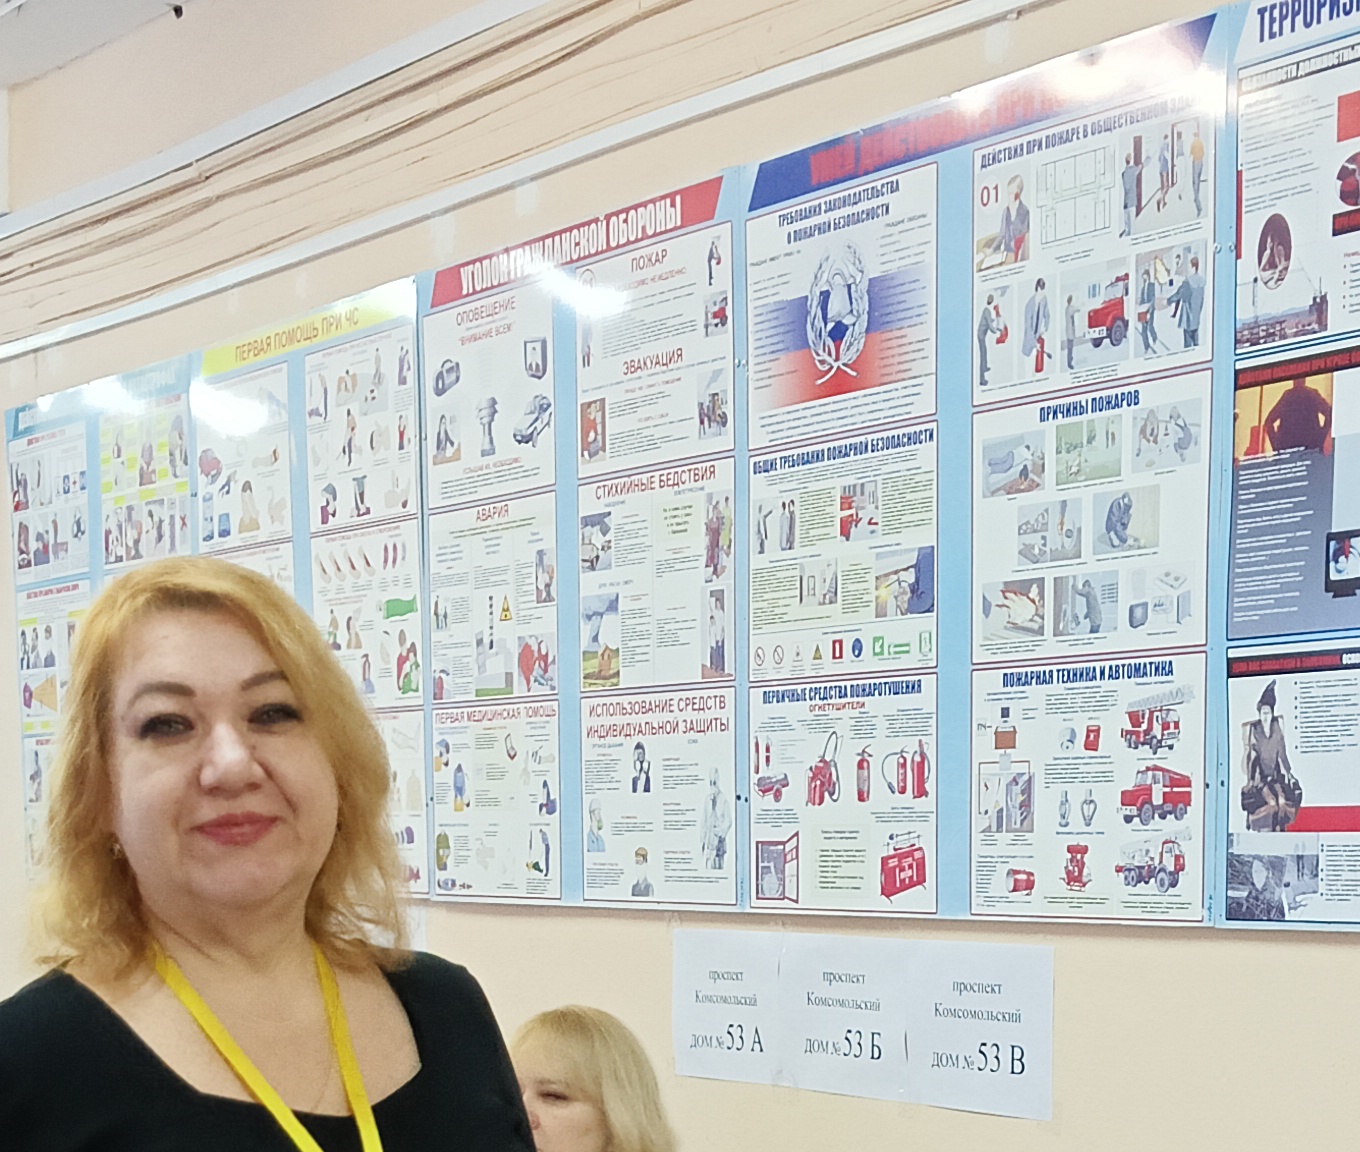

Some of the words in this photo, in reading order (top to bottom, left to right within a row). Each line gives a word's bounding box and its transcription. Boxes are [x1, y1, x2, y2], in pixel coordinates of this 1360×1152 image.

[980, 142, 1024, 171] ДЕЙСТВИЯ
[1026, 137, 1043, 155] ПРИ
[1045, 127, 1081, 150] ПОЖАРЕ
[1083, 124, 1089, 138] В
[778, 202, 822, 227] ТРЕБОВАНИЯ
[824, 179, 900, 214] ЗАКОНОДАТЕЛЬСТВА
[981, 184, 999, 207] 01
[793, 218, 831, 243] ПОЖАРНОЙ
[833, 202, 890, 231] БЕЗОПАСНОСТИ
[460, 250, 509, 295] УГОЛОК
[609, 194, 682, 247] ОБОРОНЫ
[631, 249, 668, 273] ПОЖАР
[456, 296, 516, 326] ОПОВЕЩЕНИЕ
[235, 335, 272, 363] ПЕРВАЯ
[274, 320, 319, 350] ПОМОЩЬ
[321, 313, 342, 336] ПРИ
[345, 307, 359, 327] ЧС
[623, 347, 683, 376] ЭВАКУАЦИЯ
[1040, 398, 1089, 423] ПРИЧИНЫ
[1091, 389, 1140, 414] ПОЖАРОВ
[753, 457, 778, 475] ОБЩИЕ
[779, 448, 825, 469] ТРЕБОВАНИЯ
[827, 438, 869, 461] ПОЖАРНОЙ
[871, 427, 934, 453] БЕЗОПАСНОСТИ
[595, 475, 656, 500] СТИХИЙНЫЕ
[658, 464, 716, 489] БЕДСТВИЯ
[476, 503, 509, 522] АВАРИЯ
[1003, 671, 1054, 688] ПОЖАРНАЯ
[1056, 666, 1097, 684] ТЕХНИКА
[1100, 665, 1105, 681] И
[1108, 660, 1174, 680] АВТОМАТИКА
[763, 688, 807, 704] ПЕРВИЧНЫЕ
[809, 685, 848, 701] СРЕДСТВА
[850, 679, 922, 699] ПОЖАРОТУШЕНИЯ
[435, 710, 465, 725] ПЕРВАЯ
[466, 706, 521, 723] МЕДИЦИНСКАЯ
[588, 698, 675, 719] ИСПОЛЬЗОВАНИЕ
[677, 694, 726, 714] СРЕДСТВ
[809, 701, 865, 713] ОГНЕТУШИТЕЛИ
[586, 717, 679, 739] ИНДИВИДУАЛЬНОЙ
[682, 716, 730, 735] ЗАЩИТЫ
[708, 969, 744, 984] проспект
[822, 970, 866, 987] проспект
[952, 979, 1002, 997] проспект
[694, 990, 758, 1008] Комсомольский
[806, 992, 881, 1012] Комсомольский
[934, 1002, 1022, 1024] Комсомольский
[726, 1024, 745, 1052] 53
[751, 1026, 764, 1053] А
[804, 1037, 829, 1056] ДОМ
[842, 1029, 863, 1059] 53
[870, 1031, 882, 1061] Б
[931, 1051, 959, 1070] ДОМ
[962, 1055, 975, 1071] №
[977, 1042, 1001, 1073] 53
[1010, 1045, 1025, 1075] В
